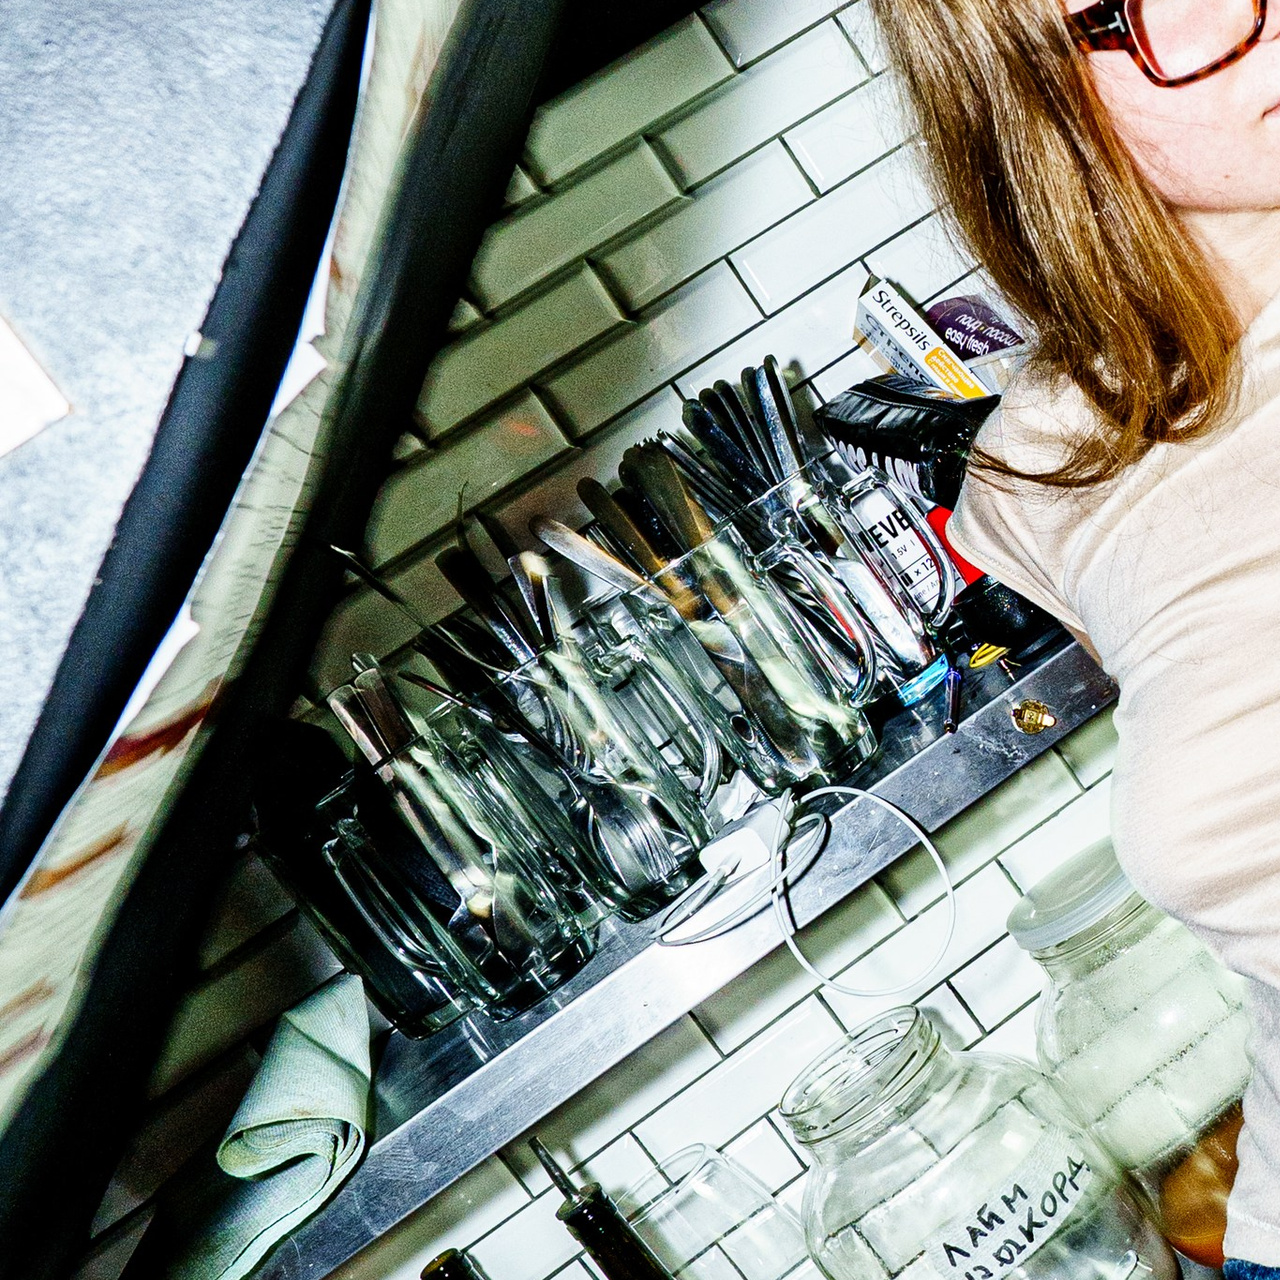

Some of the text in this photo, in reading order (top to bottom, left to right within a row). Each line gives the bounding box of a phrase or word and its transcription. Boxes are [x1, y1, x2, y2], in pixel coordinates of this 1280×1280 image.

[872, 289, 931, 351] Strepsils
[945, 327, 966, 351] easy
[943, 1183, 1028, 1266] ЛАЙМ
